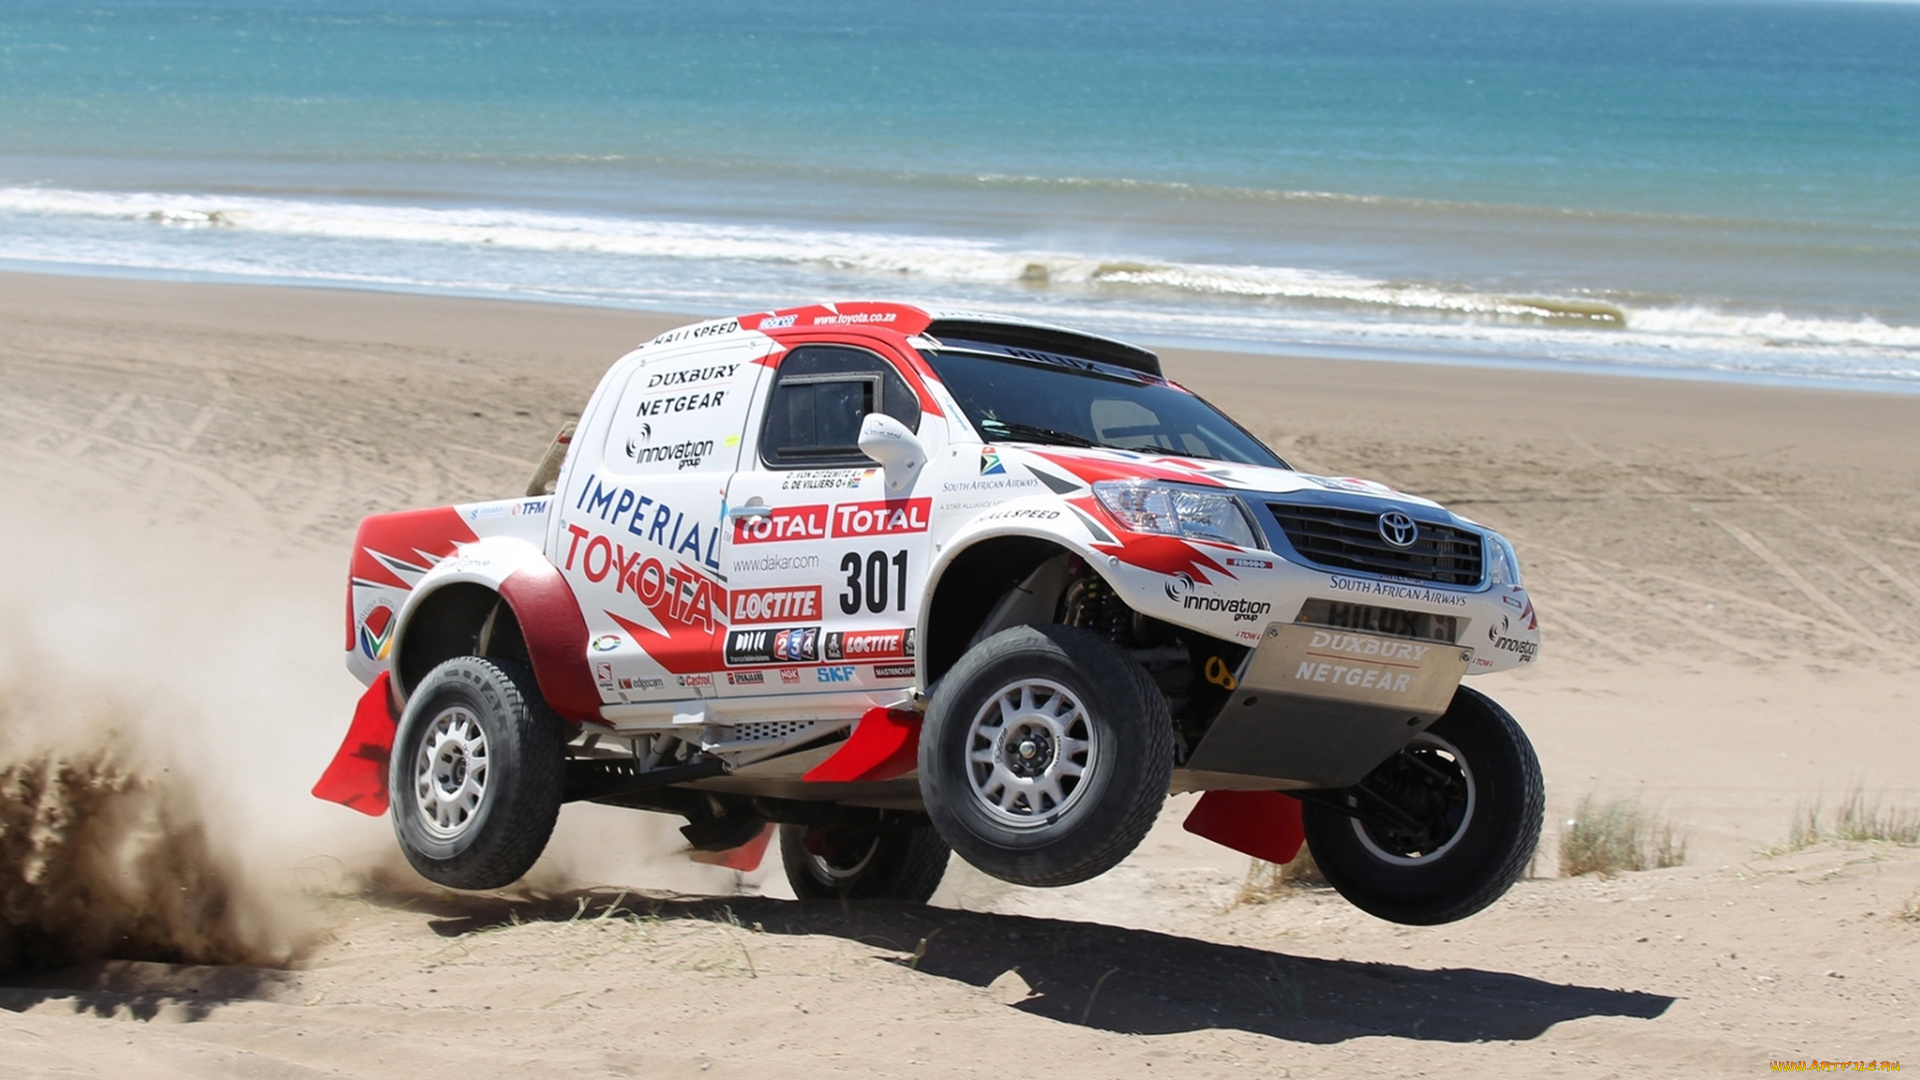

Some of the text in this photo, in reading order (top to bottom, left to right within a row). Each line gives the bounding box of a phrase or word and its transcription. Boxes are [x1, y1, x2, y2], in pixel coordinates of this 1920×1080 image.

[813, 312, 897, 326] www.toyota.co.za
[647, 363, 741, 388] DUXBURY
[636, 391, 725, 417] NETGEAR
[636, 439, 714, 464] innovation
[678, 457, 701, 470] group
[791, 479, 802, 489] DE
[802, 478, 836, 489] VILLIERS
[942, 478, 1039, 492] SOUTH AFRICAN AIRWAYS
[522, 501, 548, 515] TFM
[576, 474, 720, 570] IMPERIAL
[837, 505, 926, 534] TOTAL
[733, 553, 820, 573] www.dakar.com
[1233, 558, 1267, 568] FERODO
[565, 523, 716, 636] TOYOTA
[839, 549, 908, 616] 301
[1329, 575, 1370, 594] SOUTH
[1373, 582, 1420, 600] AFRICAN
[1421, 588, 1467, 607] AIRWAYS
[734, 590, 817, 621] LOCTITE
[1183, 595, 1271, 614] innovation
[1233, 612, 1258, 622] group
[1328, 602, 1422, 640] HILUX
[846, 635, 899, 653] LOCTITE
[1239, 631, 1258, 640] TOW
[1309, 631, 1430, 661] DUXBURY
[1474, 658, 1489, 667] TOW
[633, 676, 664, 691] edgecam
[685, 674, 711, 686] Castrol
[816, 666, 856, 683] SKF
[1295, 661, 1411, 693] NETGEAR
